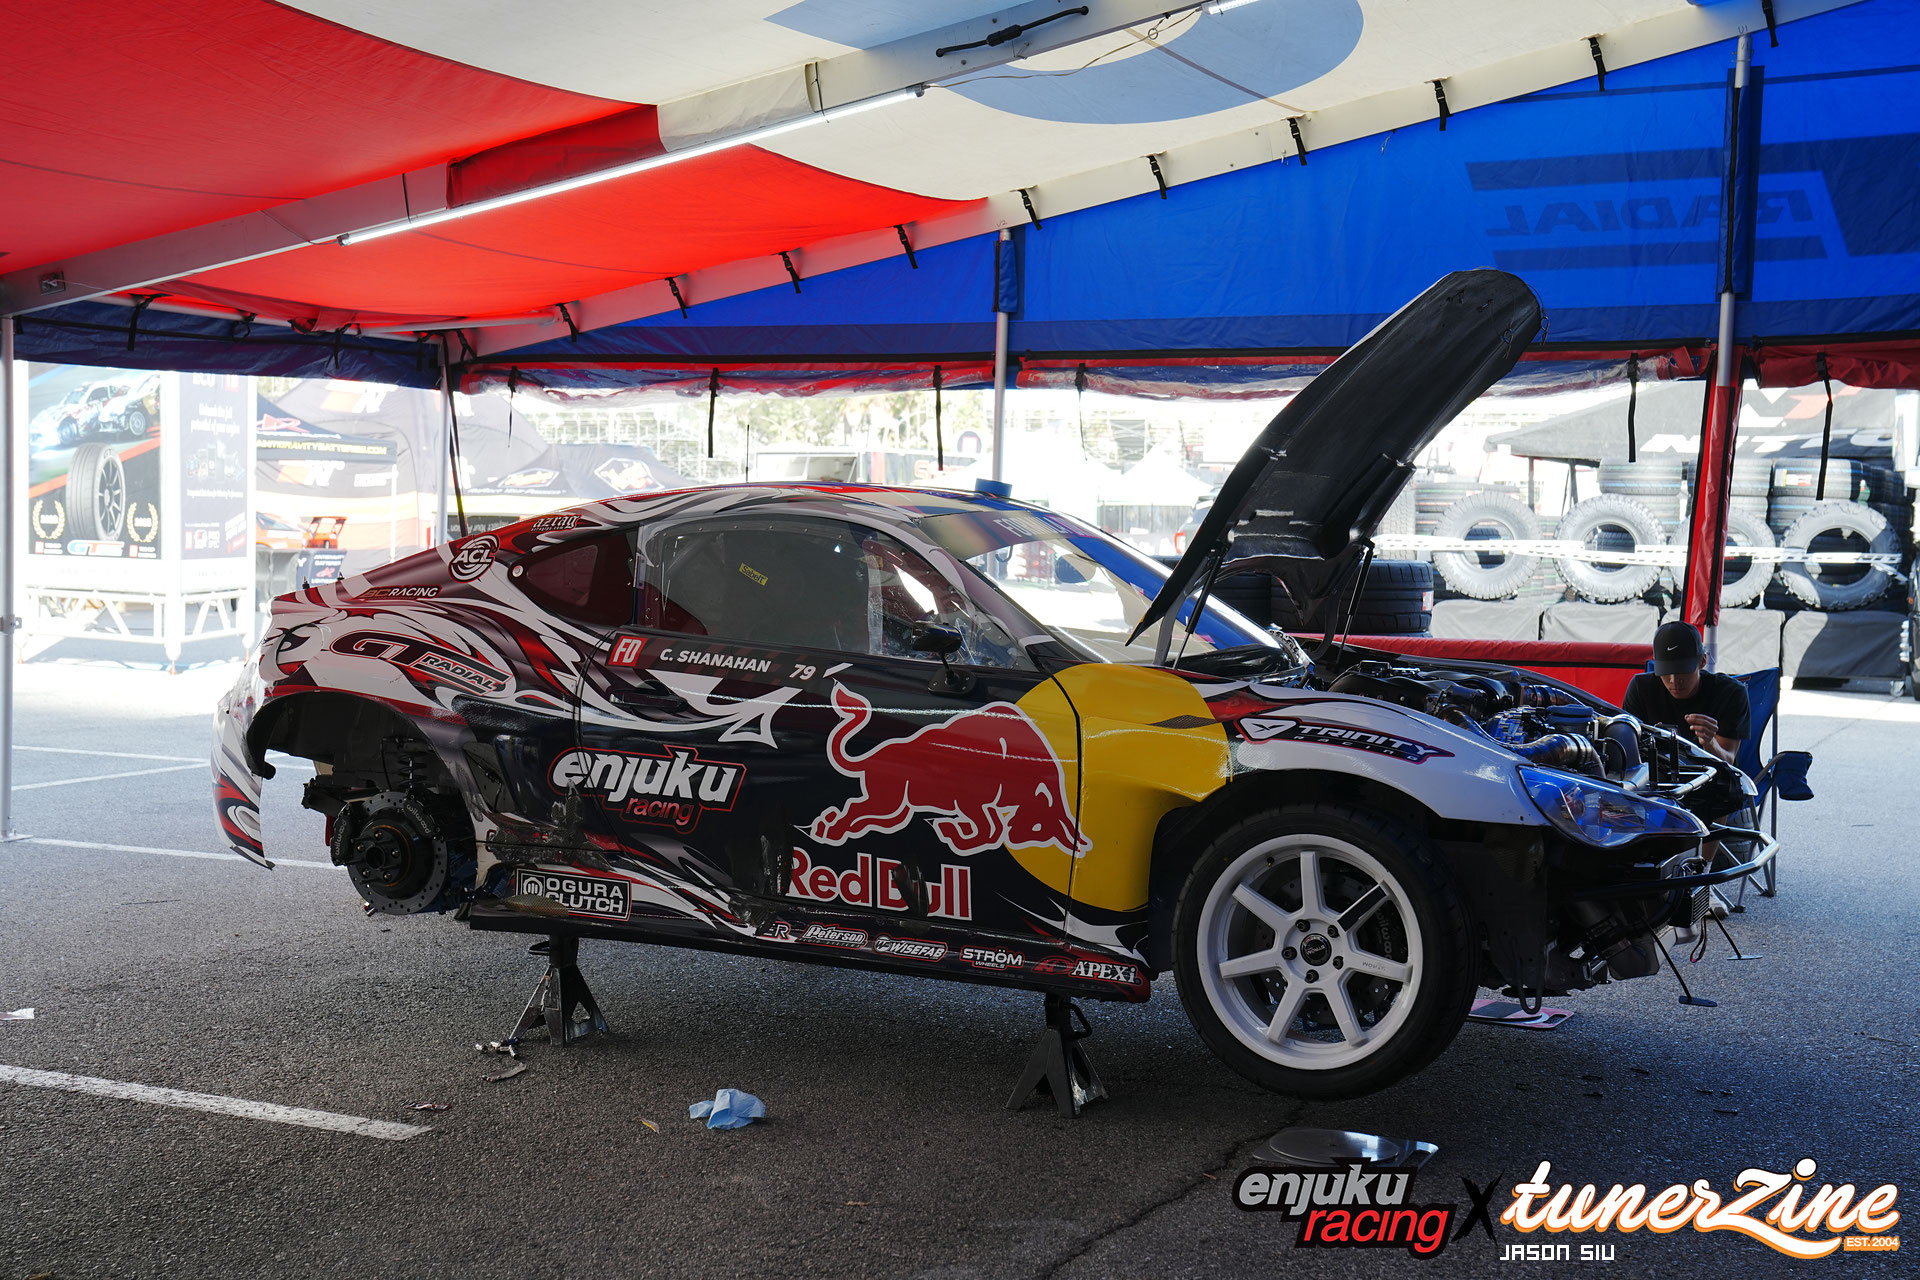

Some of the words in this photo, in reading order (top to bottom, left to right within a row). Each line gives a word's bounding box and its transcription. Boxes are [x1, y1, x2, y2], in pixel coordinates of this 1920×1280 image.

[455, 548, 494, 564] ACL
[742, 565, 767, 583] Sabelt
[388, 587, 439, 597] RACING
[614, 637, 642, 664] FD
[660, 648, 673, 661] C.
[677, 650, 772, 674] SHANAHAN
[789, 663, 817, 681] 79
[421, 654, 498, 690] RADIAL
[1297, 724, 1440, 756] TRINITY
[552, 750, 738, 803] enjuku
[406, 804, 431, 835] wilwood
[625, 797, 695, 826] racing
[334, 819, 348, 856] wilwood
[546, 877, 624, 899] OGURA
[786, 847, 872, 908] Red
[804, 924, 866, 944] Peterson
[889, 940, 945, 958] WISEFAB
[962, 947, 1024, 966] STRÖM
[974, 960, 1005, 969] WHEELS
